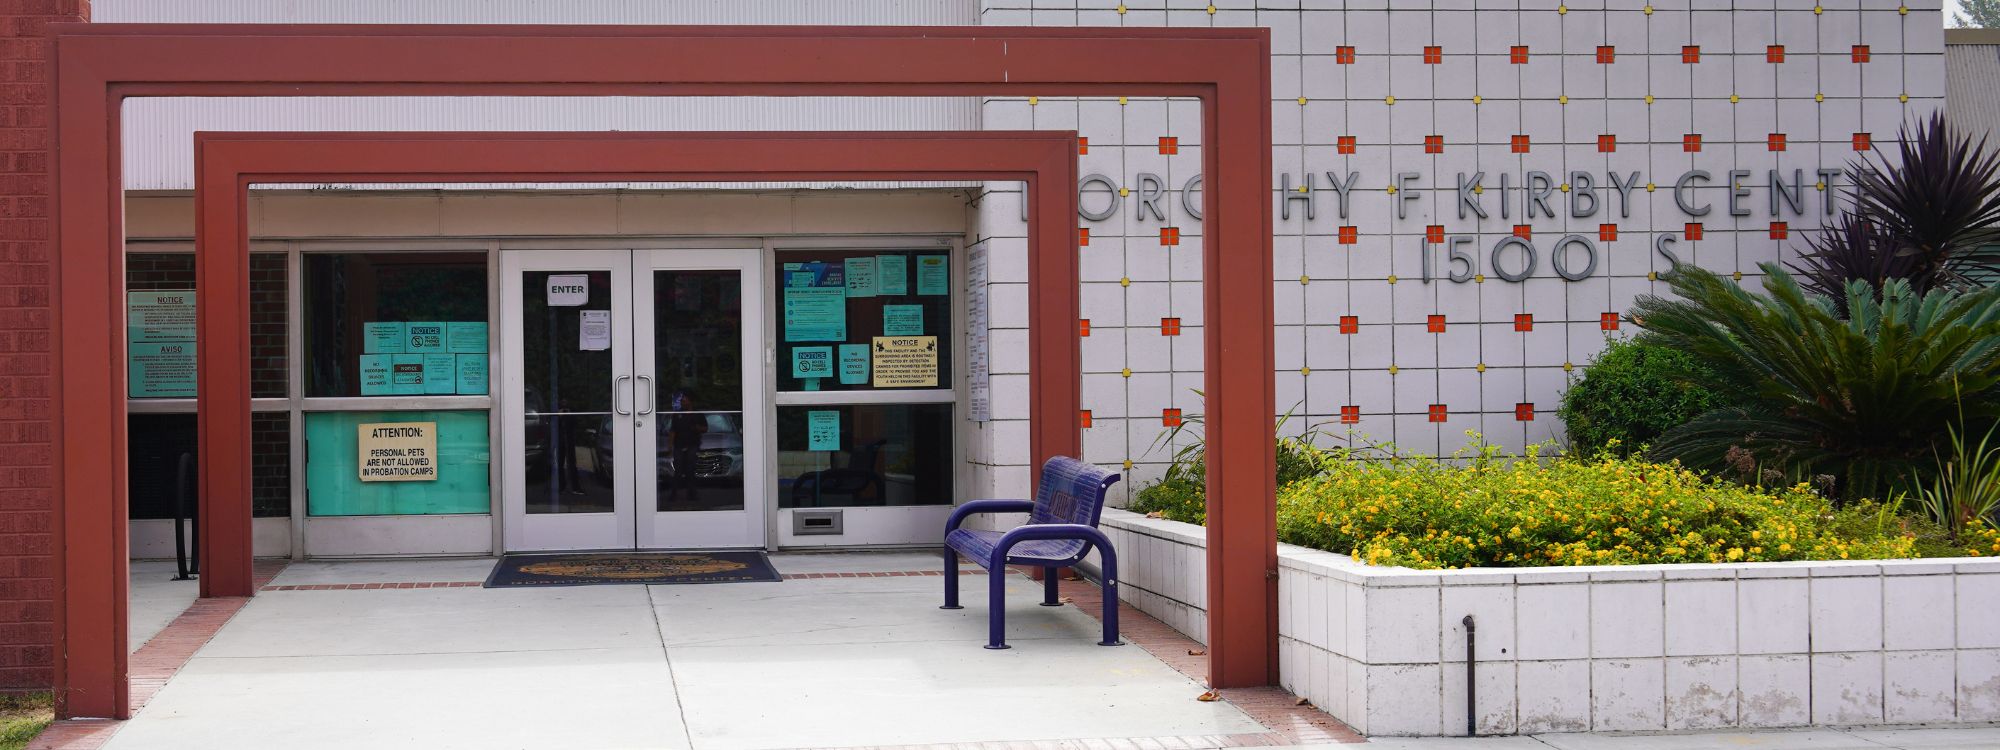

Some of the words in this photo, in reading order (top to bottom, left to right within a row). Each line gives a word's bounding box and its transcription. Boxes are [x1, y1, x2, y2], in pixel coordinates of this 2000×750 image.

[1457, 170, 1641, 220] KIRBY
[1421, 234, 1599, 284] 1500
[1656, 232, 1680, 281] S
[551, 285, 585, 294] ENTER
[160, 345, 183, 353] AVISO
[372, 427, 423, 438] ATTENTION:
[371, 449, 406, 457] PERSONAL
[407, 448, 425, 456] PETS
[367, 458, 380, 466] ARE
[381, 458, 395, 466] NOT
[397, 458, 430, 466] ALLOWED
[362, 468, 369, 476] IN
[371, 468, 409, 476] PROBATION
[410, 467, 433, 475] CAMPS
